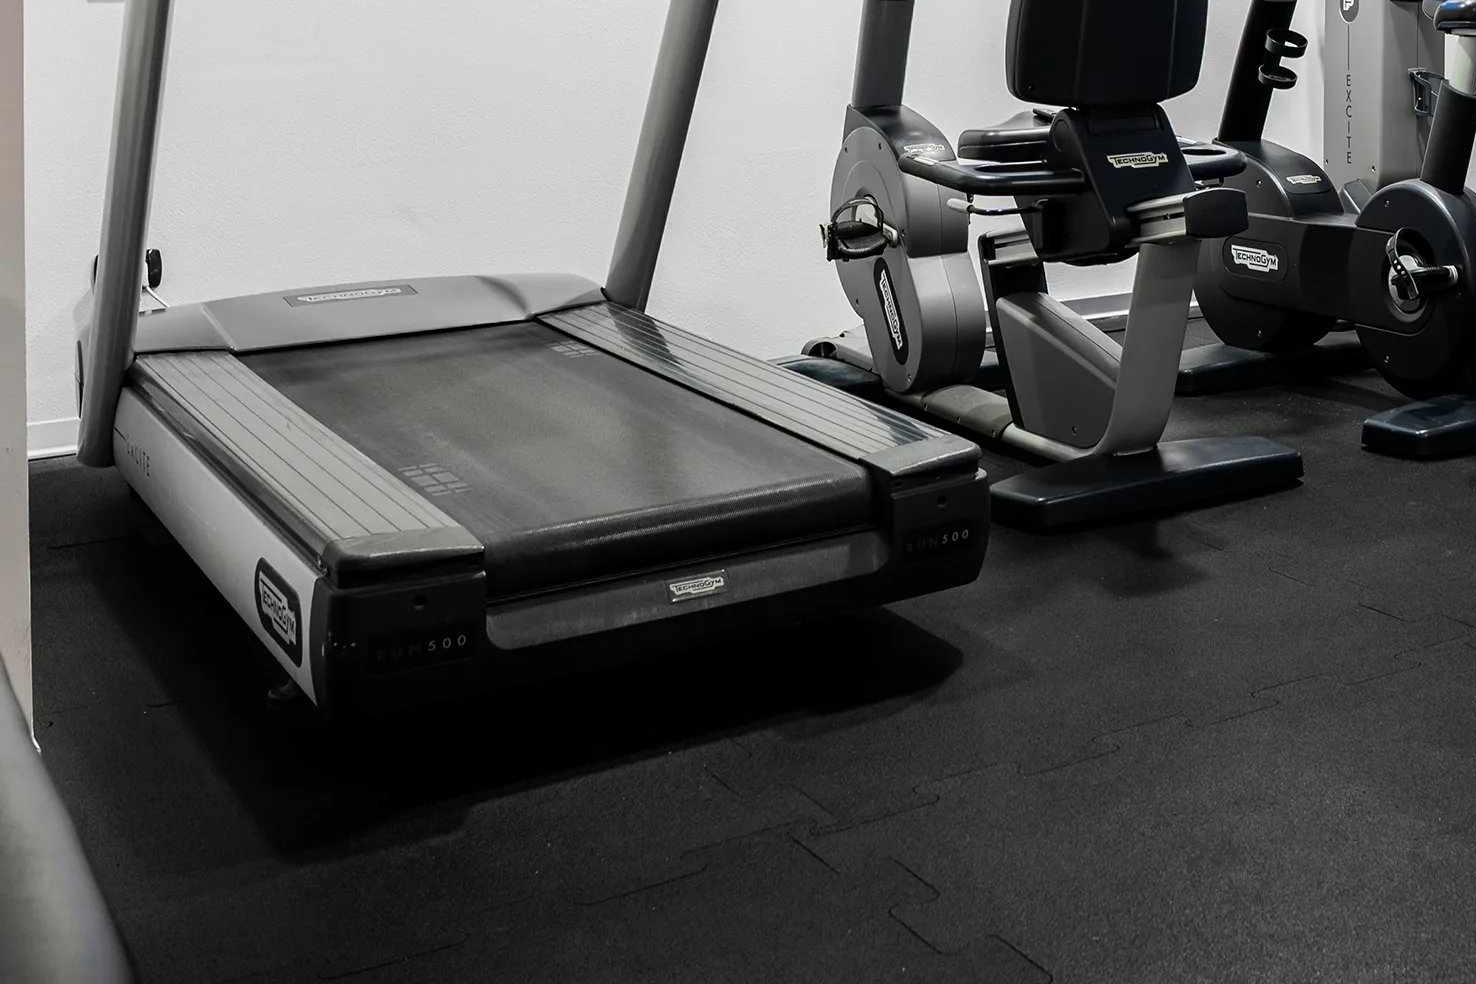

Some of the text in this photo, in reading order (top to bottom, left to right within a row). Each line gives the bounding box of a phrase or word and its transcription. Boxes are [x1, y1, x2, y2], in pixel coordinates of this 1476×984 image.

[1345, 74, 1353, 165] EXCITE
[1108, 153, 1167, 167] TECHNOGYM
[1232, 246, 1278, 271] TECHNOGYM
[670, 577, 723, 594] TECHNOGYM
[260, 573, 296, 642] TECHNOGYM
